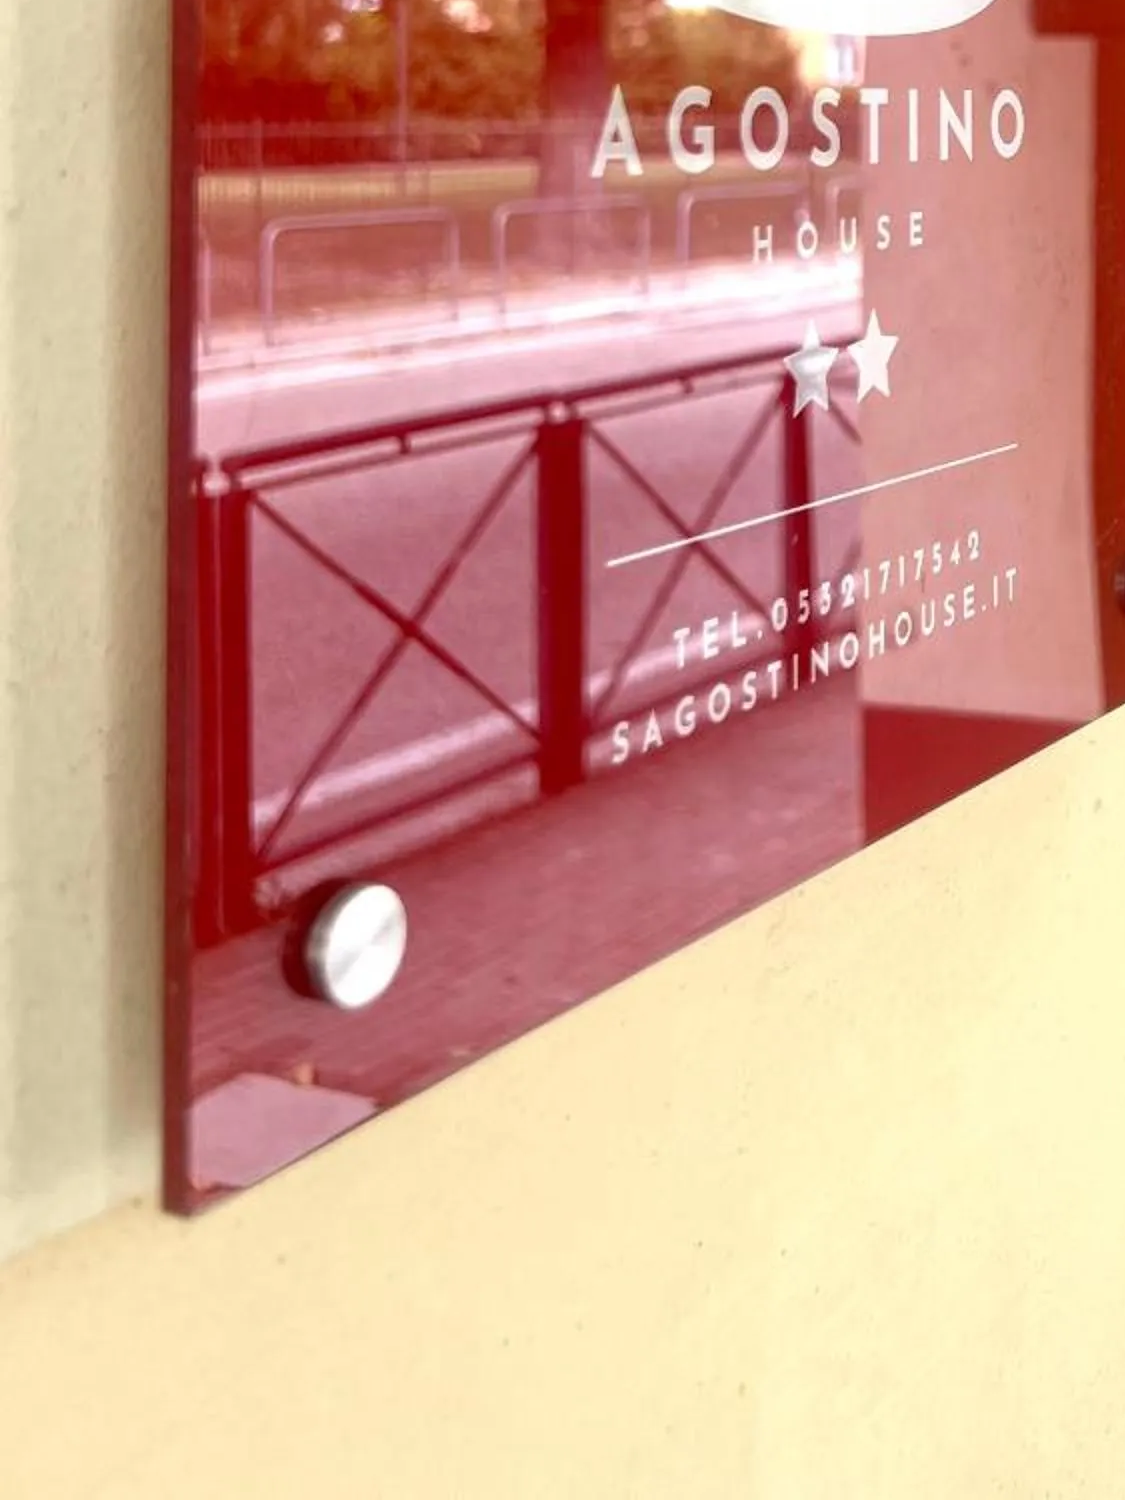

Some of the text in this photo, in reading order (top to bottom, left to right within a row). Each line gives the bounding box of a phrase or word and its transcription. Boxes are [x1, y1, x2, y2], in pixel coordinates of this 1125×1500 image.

[590, 84, 1025, 177] AGOSTINO
[751, 211, 925, 264] HOUSE
[611, 568, 1018, 765] SAGOSTINOHOUSE.IT
